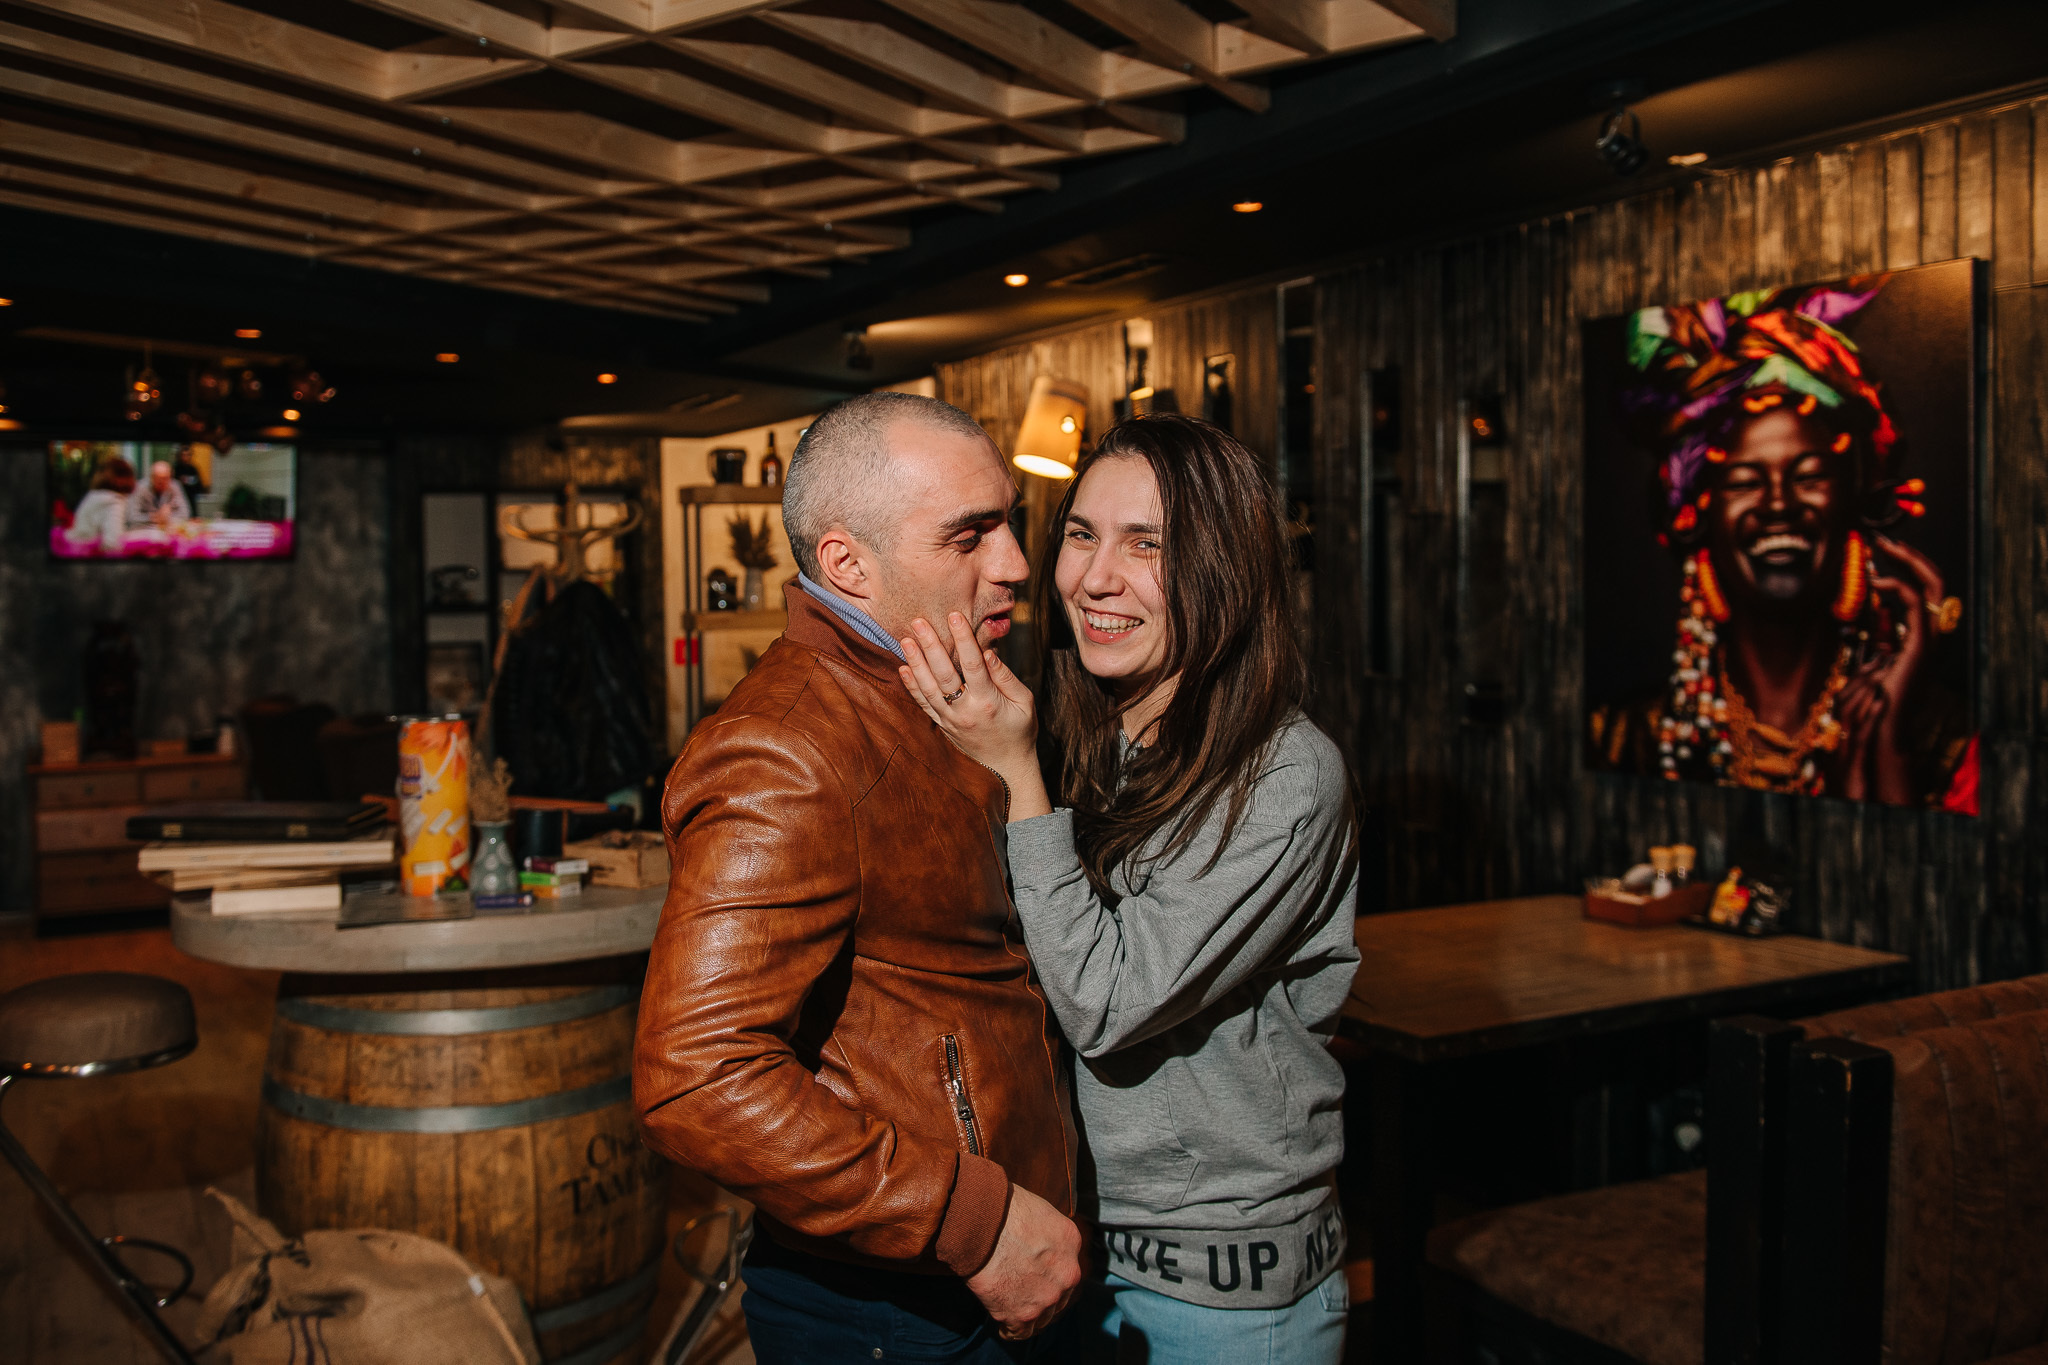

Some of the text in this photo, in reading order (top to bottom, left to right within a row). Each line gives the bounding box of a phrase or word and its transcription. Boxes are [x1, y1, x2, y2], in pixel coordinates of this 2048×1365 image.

[1106, 1207, 1342, 1293] IVE UP NE
